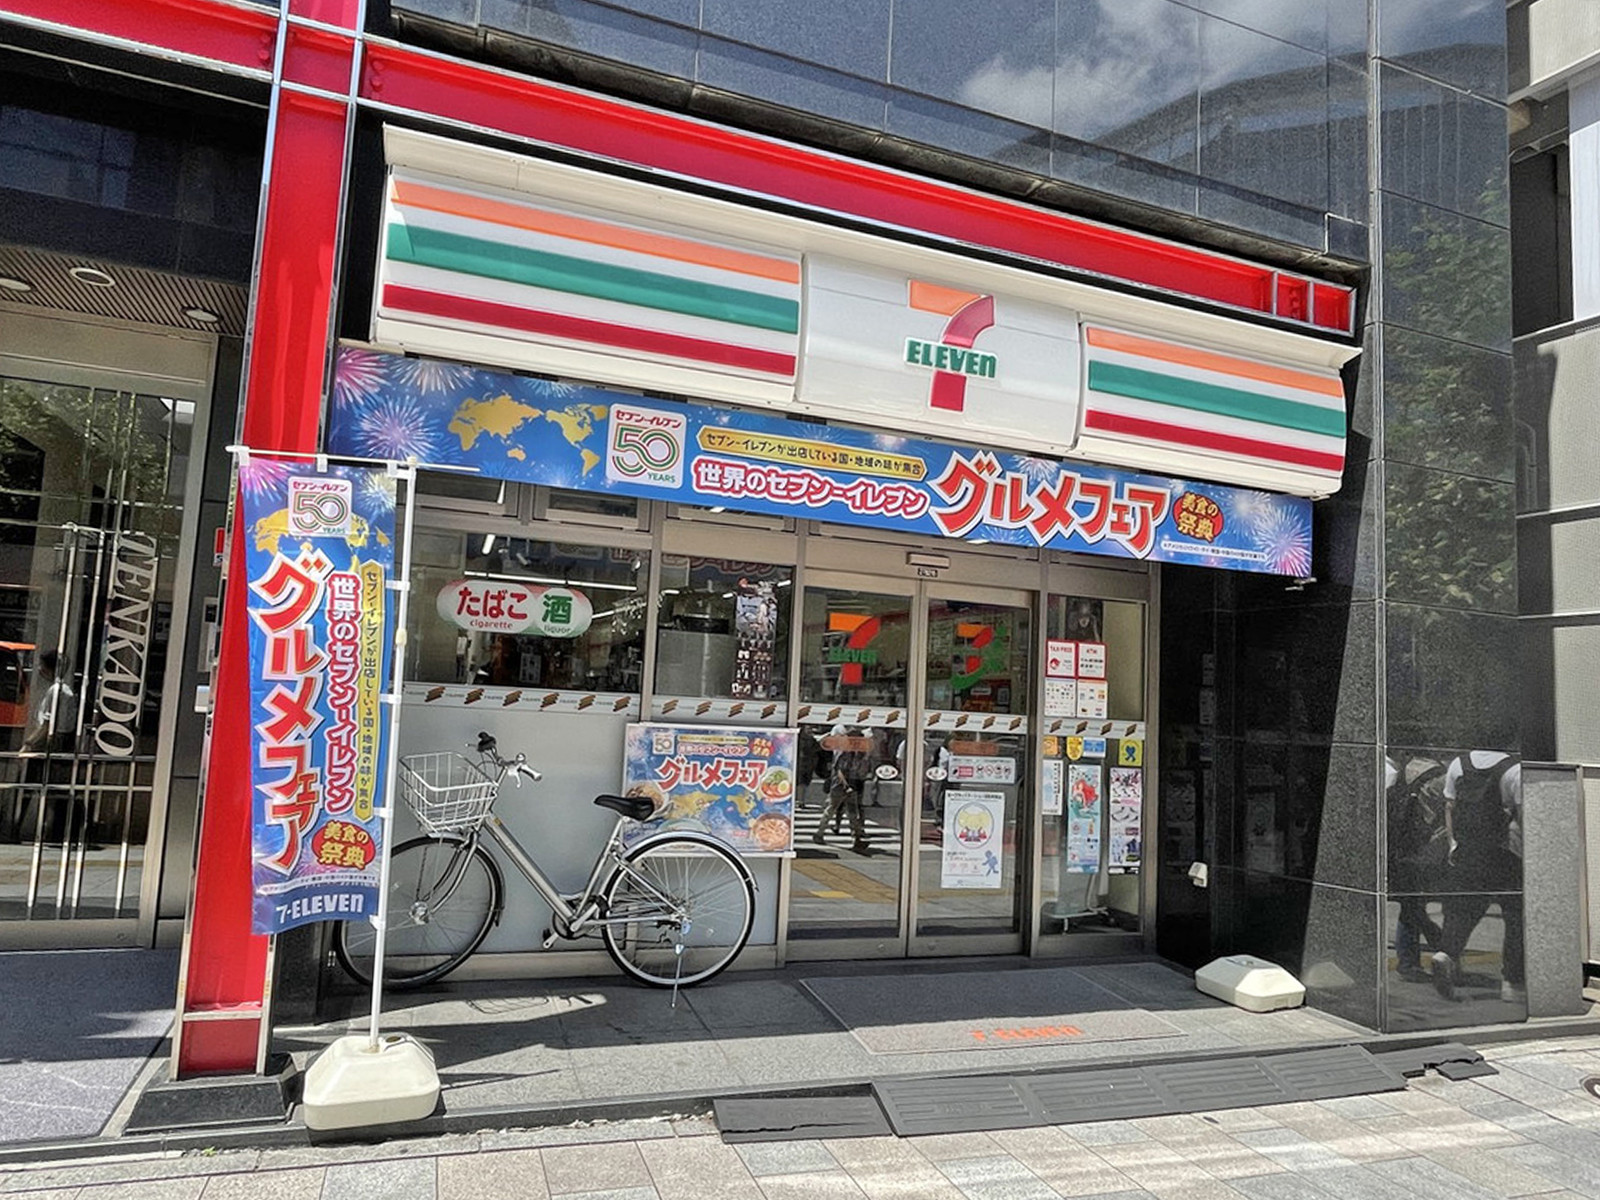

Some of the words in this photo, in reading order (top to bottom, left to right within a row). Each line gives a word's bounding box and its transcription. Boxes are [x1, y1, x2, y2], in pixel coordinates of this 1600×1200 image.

[908, 279, 995, 412] 7
[612, 423, 680, 477] 50
[647, 472, 676, 482] YEARS
[292, 491, 348, 533] 50
[933, 455, 1169, 551] グルメフェア
[1181, 492, 1218, 516] 美食の
[1178, 511, 1215, 542] 祭典
[456, 586, 528, 619] たばこ
[541, 594, 573, 625] 酒
[469, 619, 513, 629] cigarette
[544, 624, 571, 634] liquor
[95, 532, 157, 756] TENKADO
[258, 556, 326, 869] グルメフェア
[658, 757, 768, 792] グルメフェア
[324, 821, 368, 845] 美食の
[320, 842, 366, 868] 祭典
